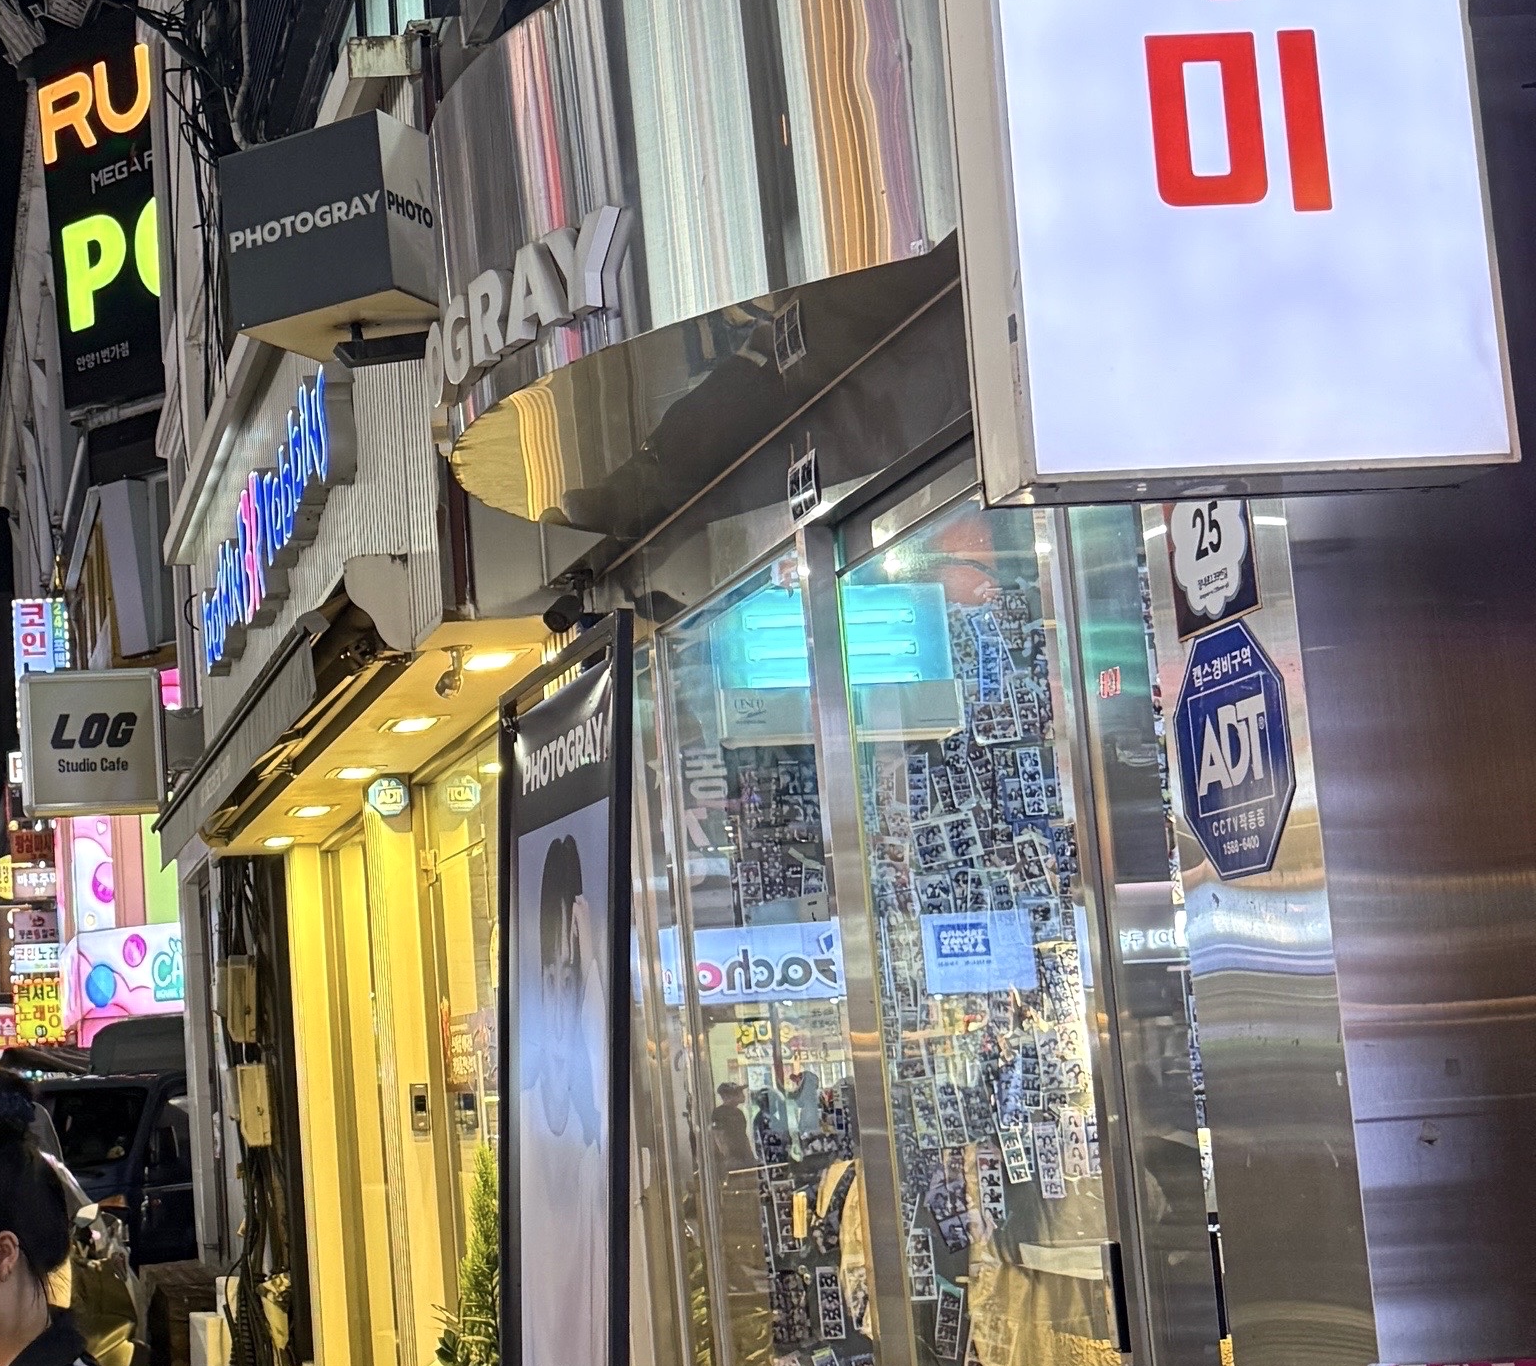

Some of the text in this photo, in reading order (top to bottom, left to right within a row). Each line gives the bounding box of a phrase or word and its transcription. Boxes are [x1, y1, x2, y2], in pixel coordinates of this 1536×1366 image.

[229, 188, 381, 254] PHOTOGRAY
[386, 188, 434, 229] PHOTO
[1192, 500, 1222, 562] 25
[50, 711, 138, 750] LOG
[1198, 692, 1266, 798] ADT
[58, 756, 129, 774] Studio Cafe
[522, 711, 604, 797] PHOTOGRAY
[377, 786, 403, 804] ADT
[1212, 807, 1266, 838] CCTV작동중
[20, 1004, 62, 1028] 노래방
